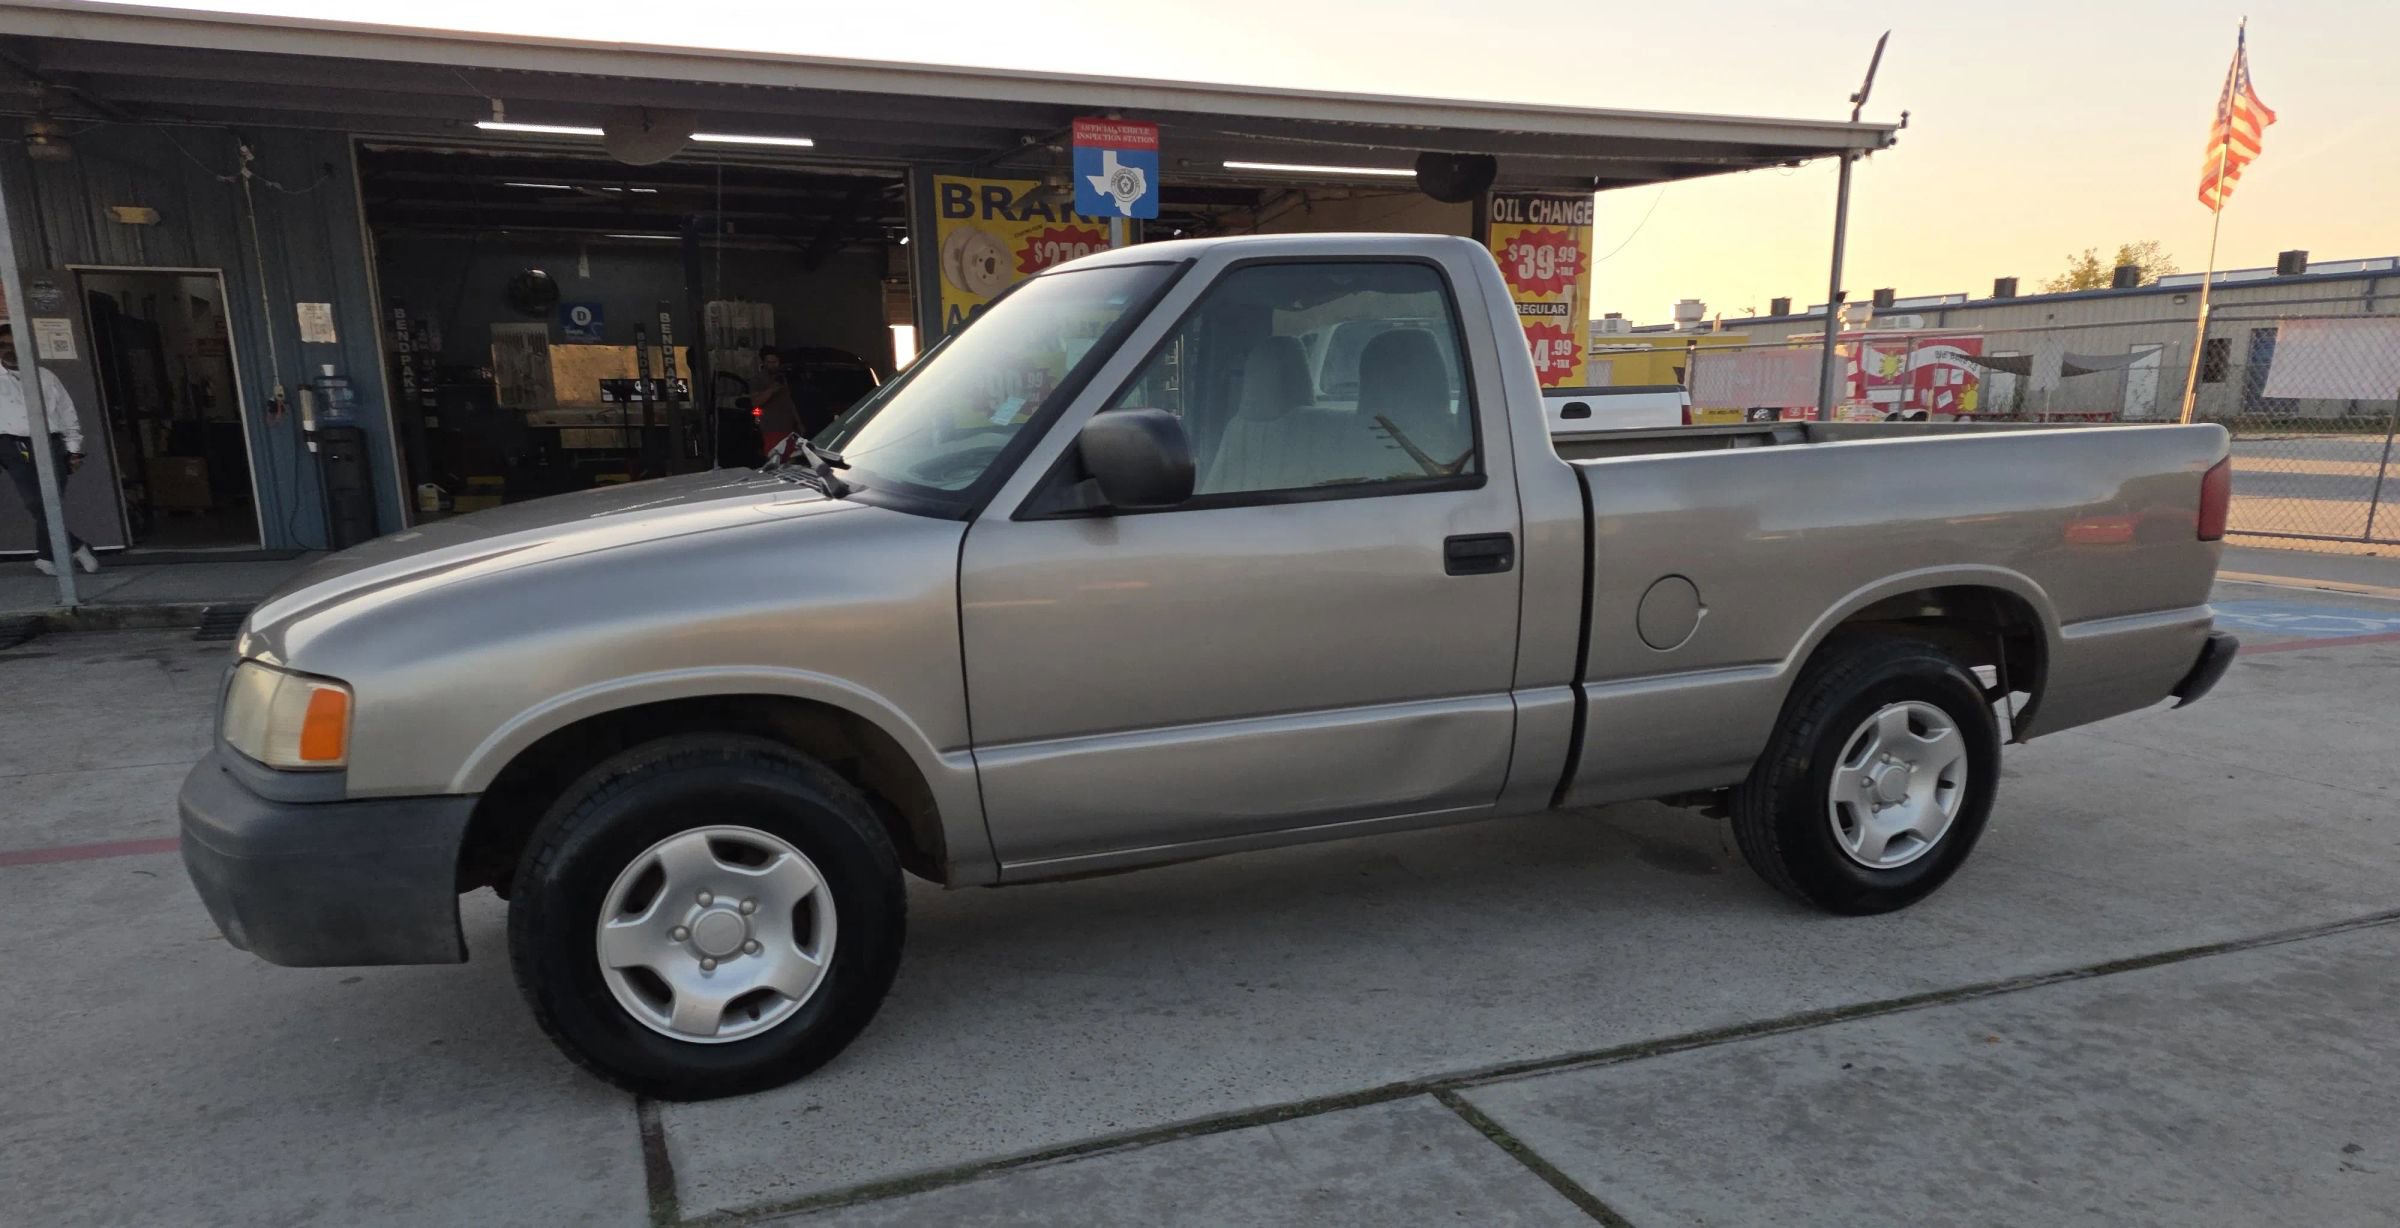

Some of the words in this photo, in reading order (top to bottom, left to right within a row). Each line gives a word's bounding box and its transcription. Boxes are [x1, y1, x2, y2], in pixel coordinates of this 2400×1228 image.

[1076, 132, 1121, 142] INSPECTION
[1123, 135, 1155, 144] STATION
[1080, 124, 1115, 133] OFFICIAL
[1117, 126, 1150, 135] VEHICLE
[1493, 198, 1523, 222] OIL
[1529, 199, 1593, 225] CHANGE
[1508, 244, 1577, 280] $39.99
[1516, 304, 1566, 314] REGULAR
[659, 312, 677, 389] BENDPAK
[1529, 339, 1572, 372] 4.99
